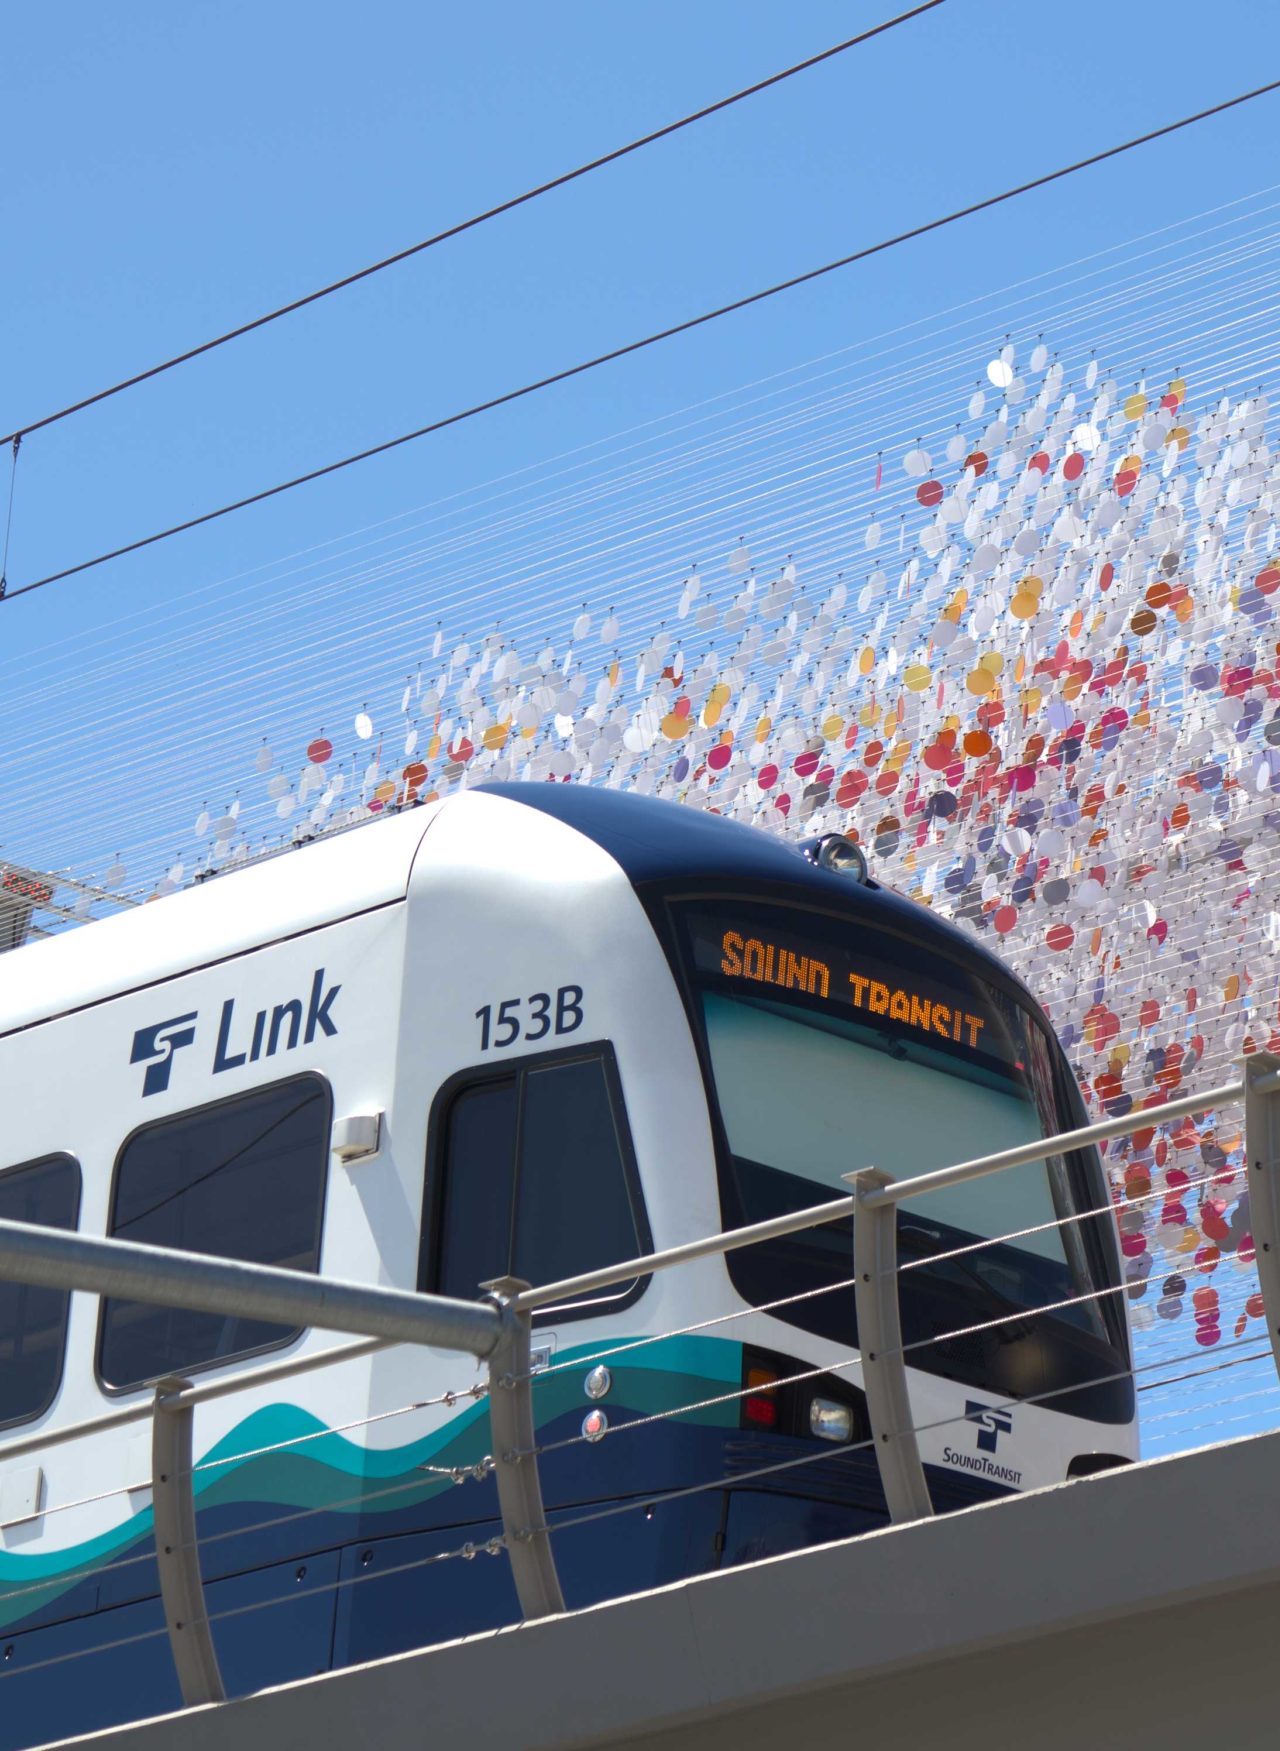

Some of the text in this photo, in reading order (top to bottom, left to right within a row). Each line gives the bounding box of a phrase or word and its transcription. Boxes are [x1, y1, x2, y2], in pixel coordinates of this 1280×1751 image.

[212, 967, 342, 1075] Link
[475, 984, 583, 1051] 153B
[721, 930, 985, 1048] SOUND TRANSIT
